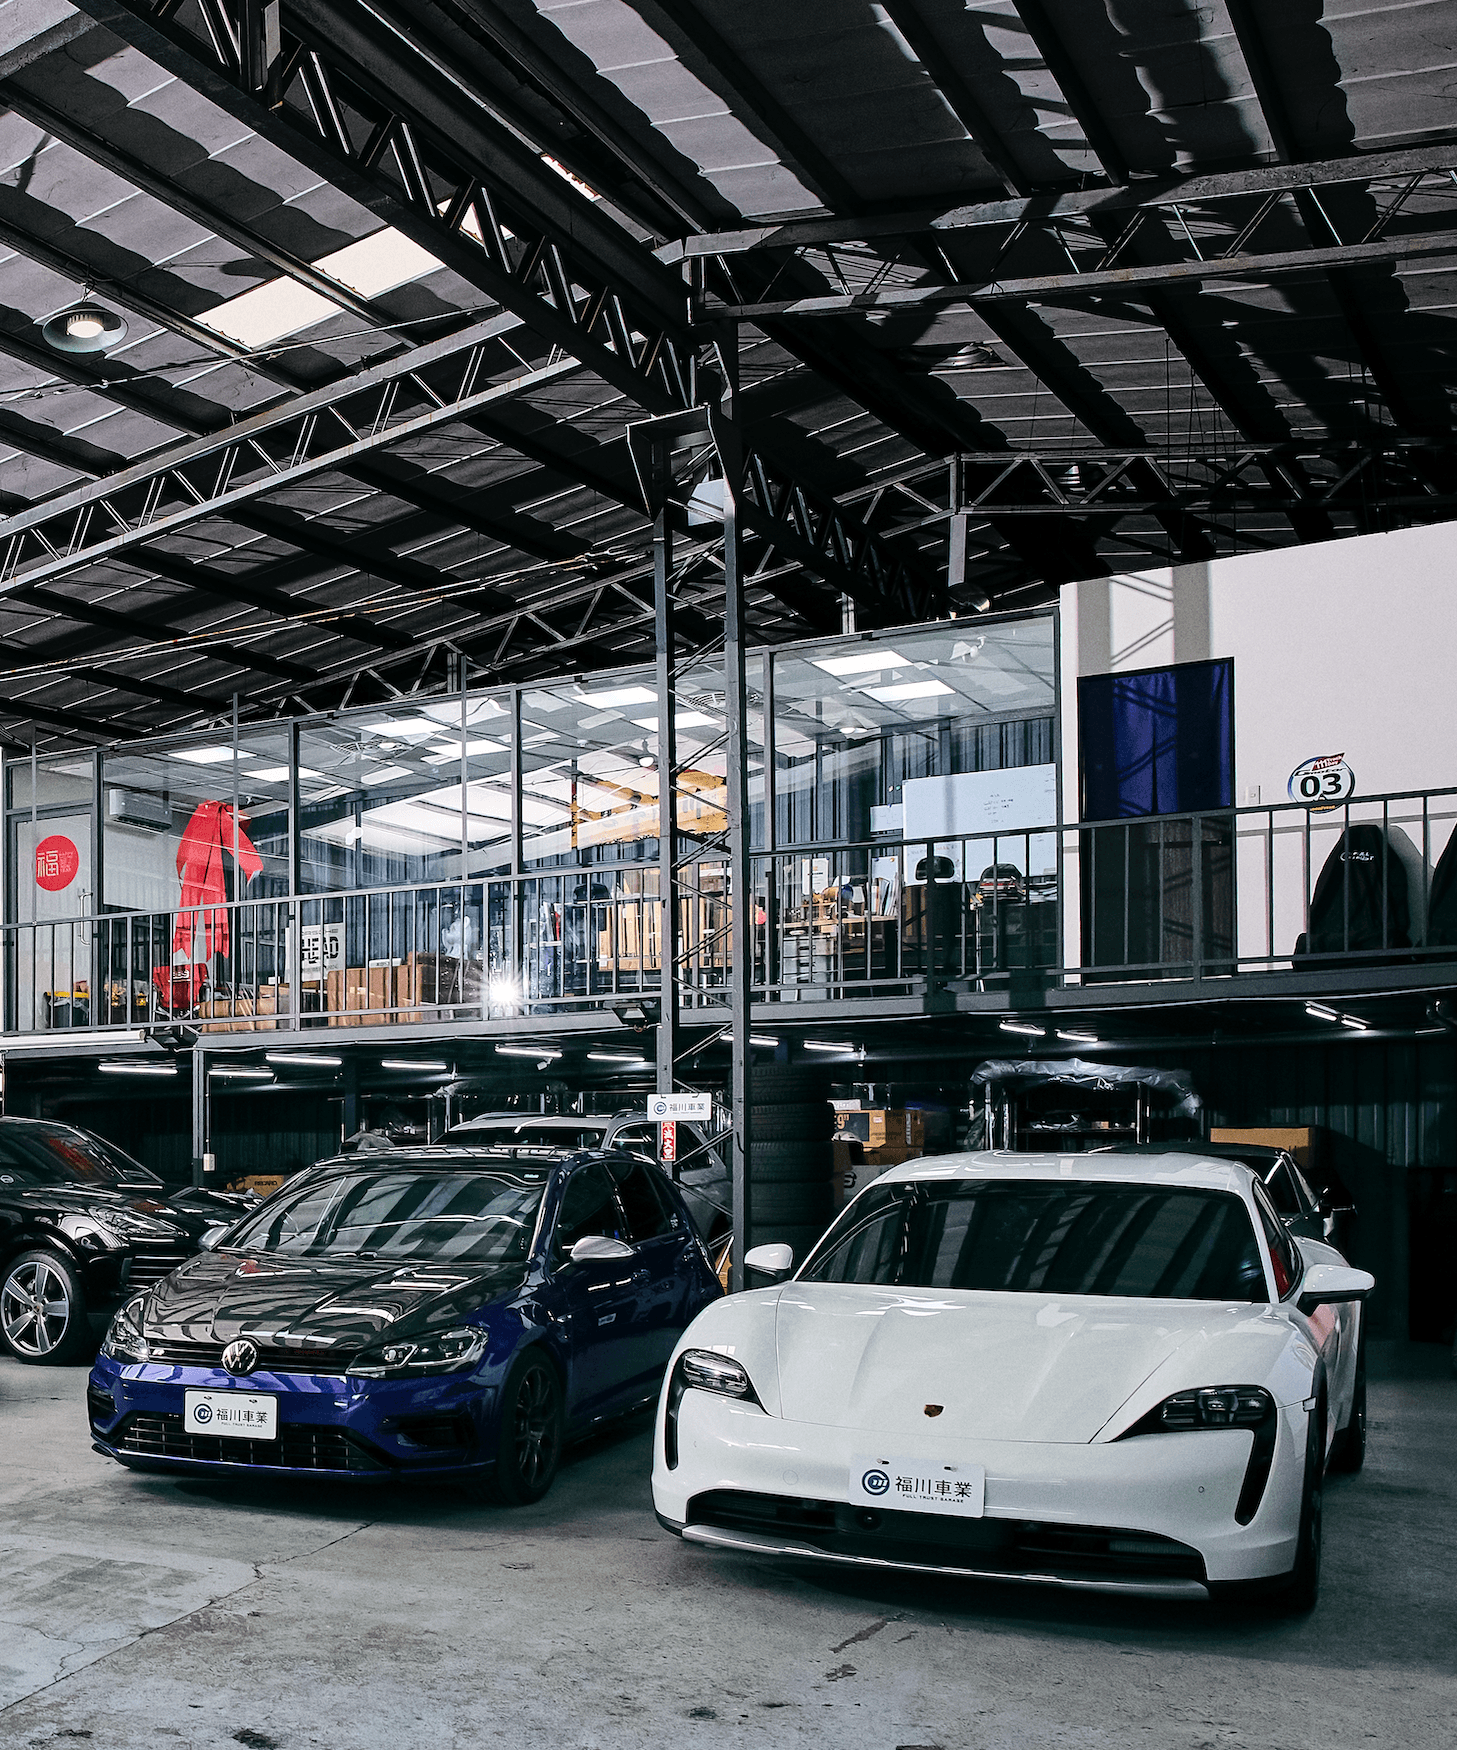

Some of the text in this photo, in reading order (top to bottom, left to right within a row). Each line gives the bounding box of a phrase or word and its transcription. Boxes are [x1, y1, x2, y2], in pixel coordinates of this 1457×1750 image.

[1300, 773, 1342, 797] 03
[216, 1408, 268, 1424] 福川車業
[895, 1475, 973, 1498] 福川車業
